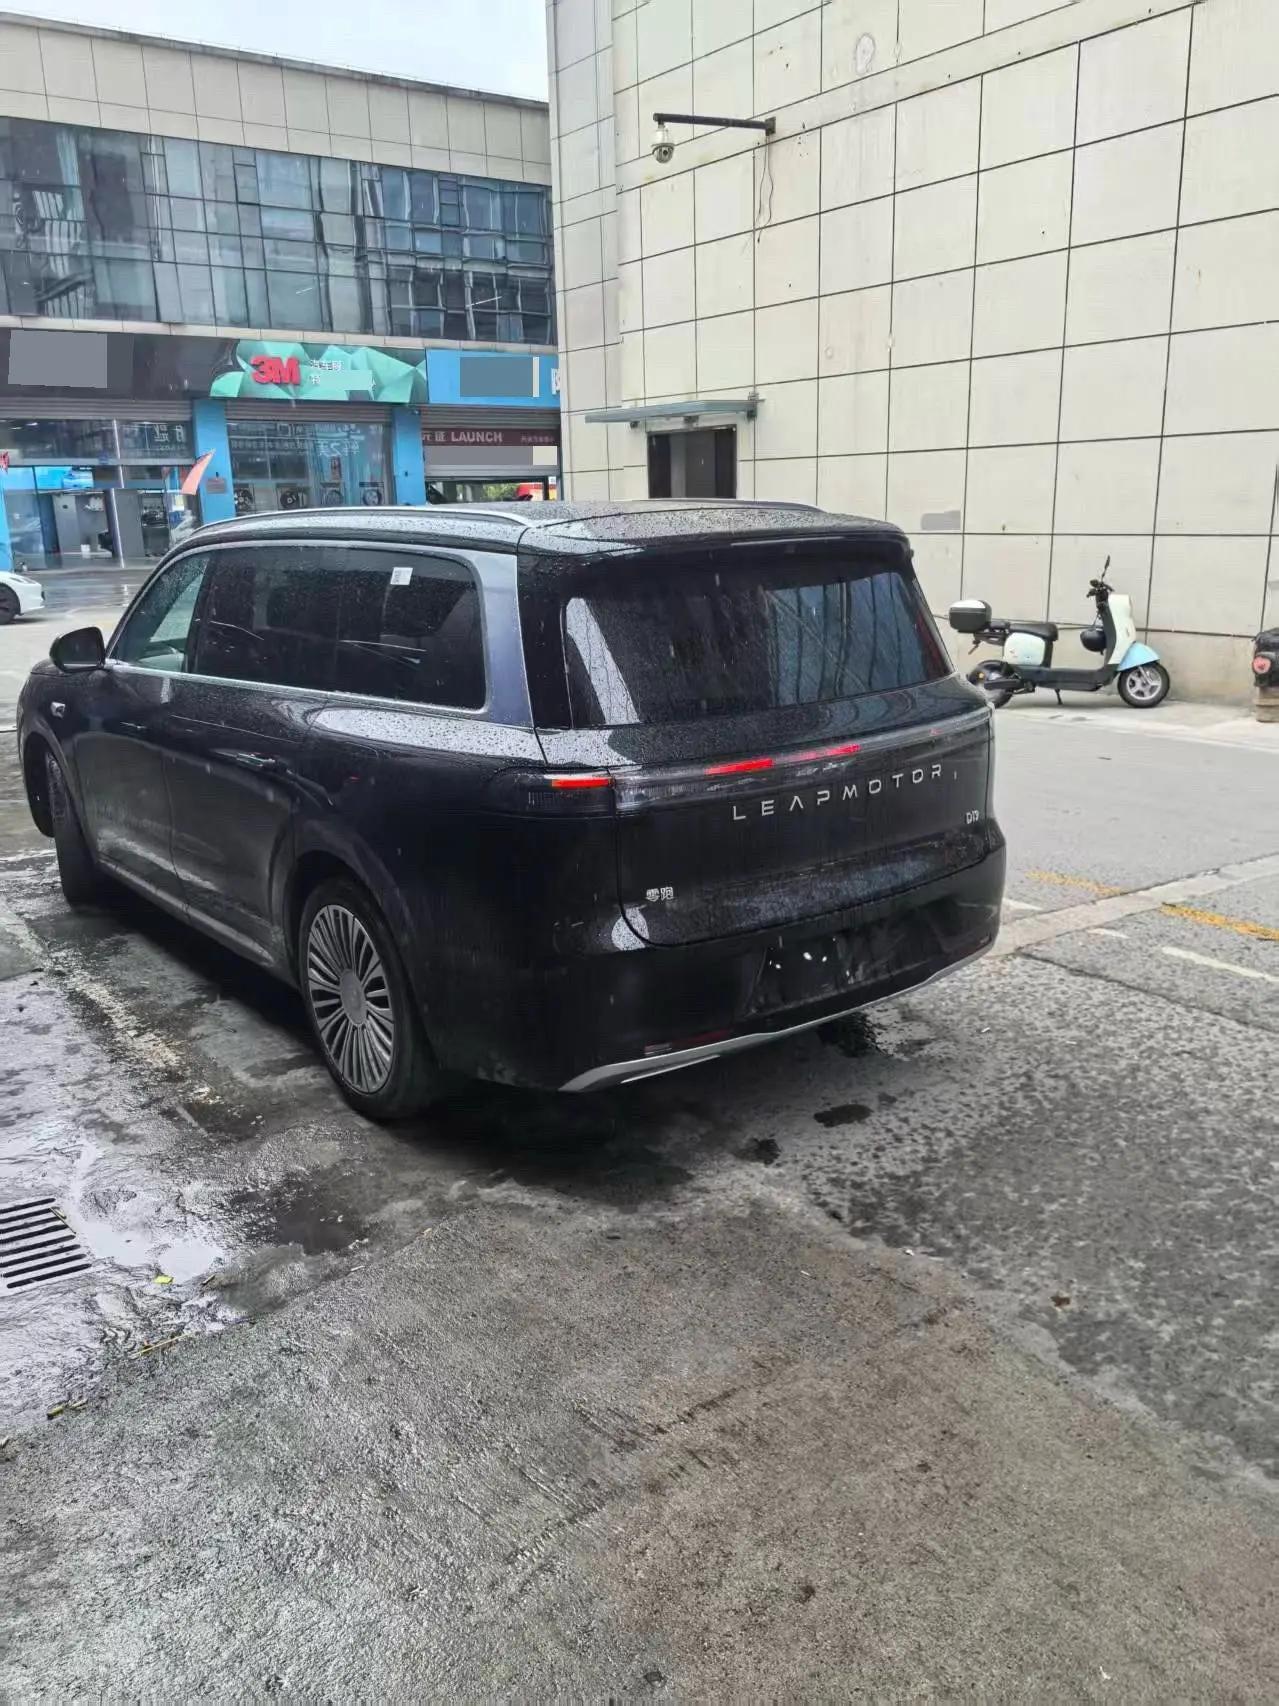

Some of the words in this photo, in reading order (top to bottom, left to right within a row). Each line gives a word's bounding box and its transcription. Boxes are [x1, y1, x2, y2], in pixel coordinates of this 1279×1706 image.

[250, 355, 300, 384] 3M
[451, 431, 503, 442] LAUNCH
[732, 763, 942, 821] LEAPMOTOR
